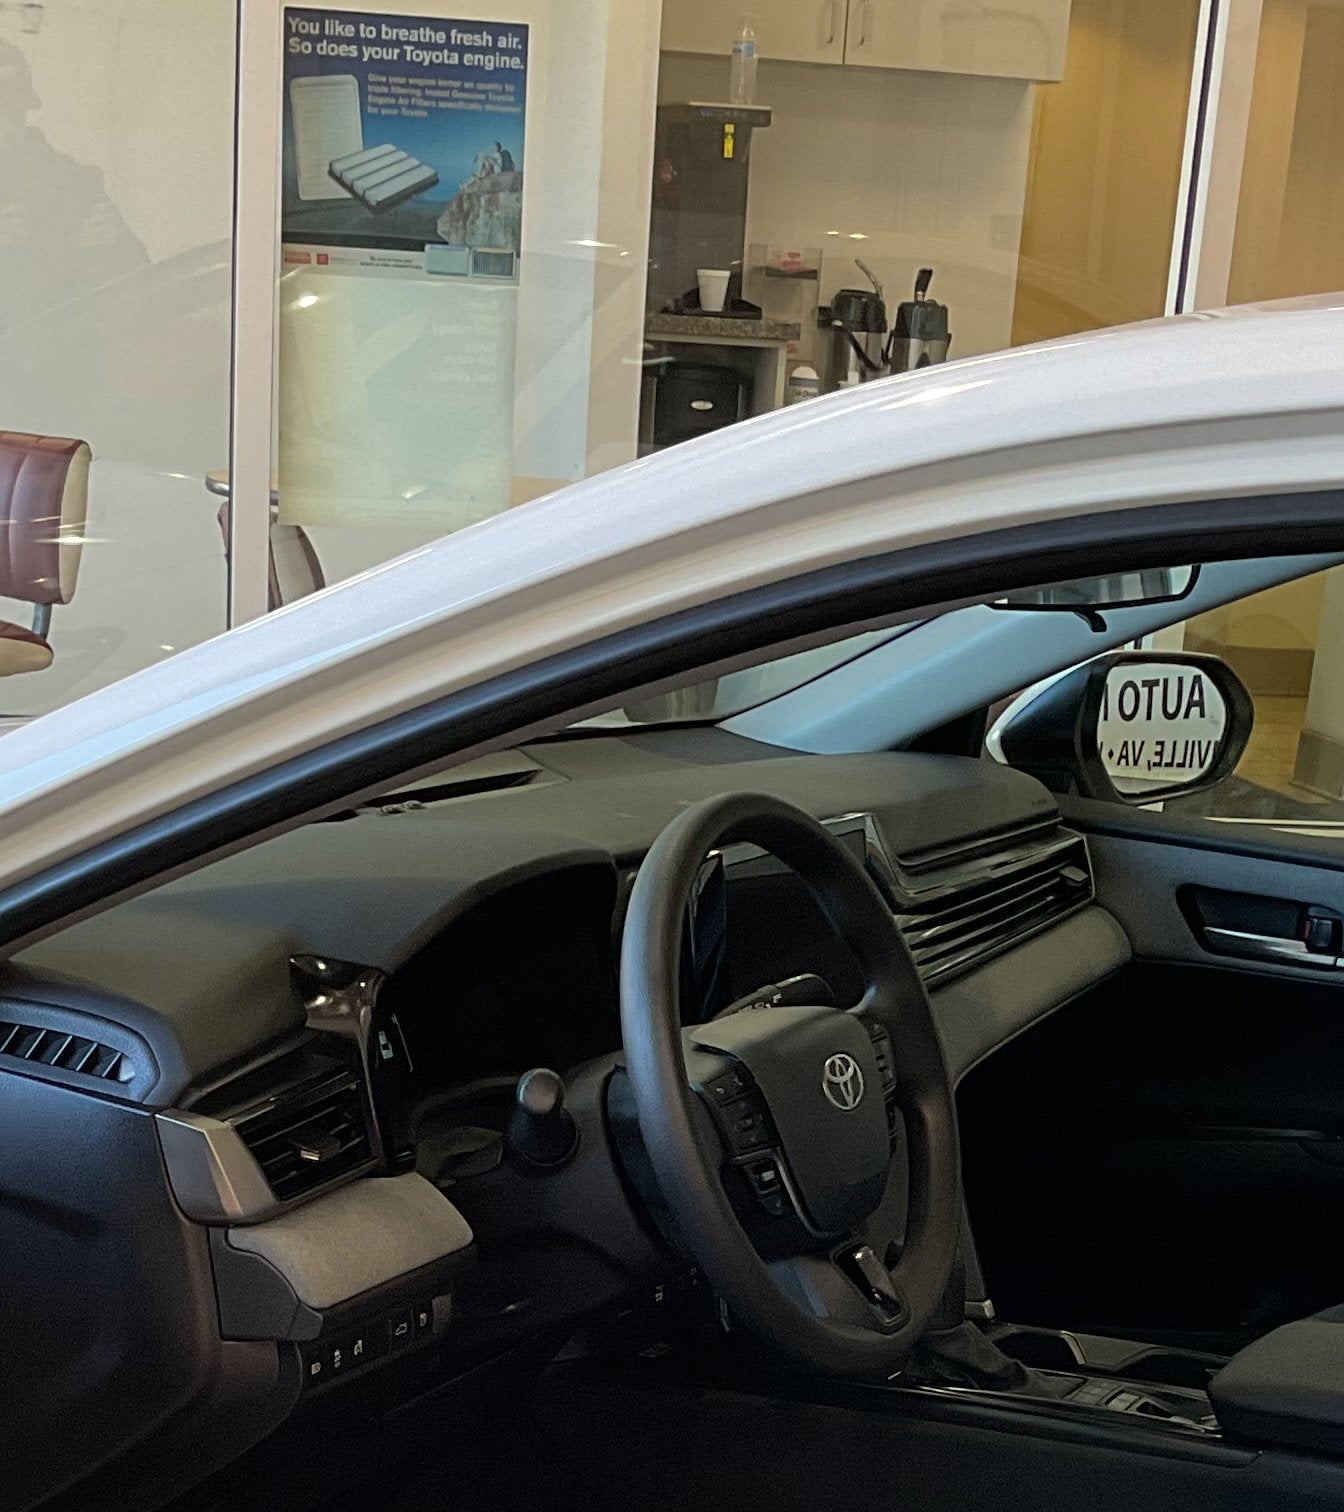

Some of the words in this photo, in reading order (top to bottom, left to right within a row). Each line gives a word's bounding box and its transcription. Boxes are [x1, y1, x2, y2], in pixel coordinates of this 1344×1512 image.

[289, 17, 320, 34] You
[325, 19, 355, 37] like
[360, 23, 377, 38] to
[381, 24, 446, 44] breathe
[451, 28, 492, 47] fresh
[498, 32, 522, 50] air.
[289, 37, 312, 54] So
[317, 39, 358, 57] does
[361, 45, 400, 62] your
[403, 45, 459, 66] Toyota
[463, 51, 524, 71] engine.
